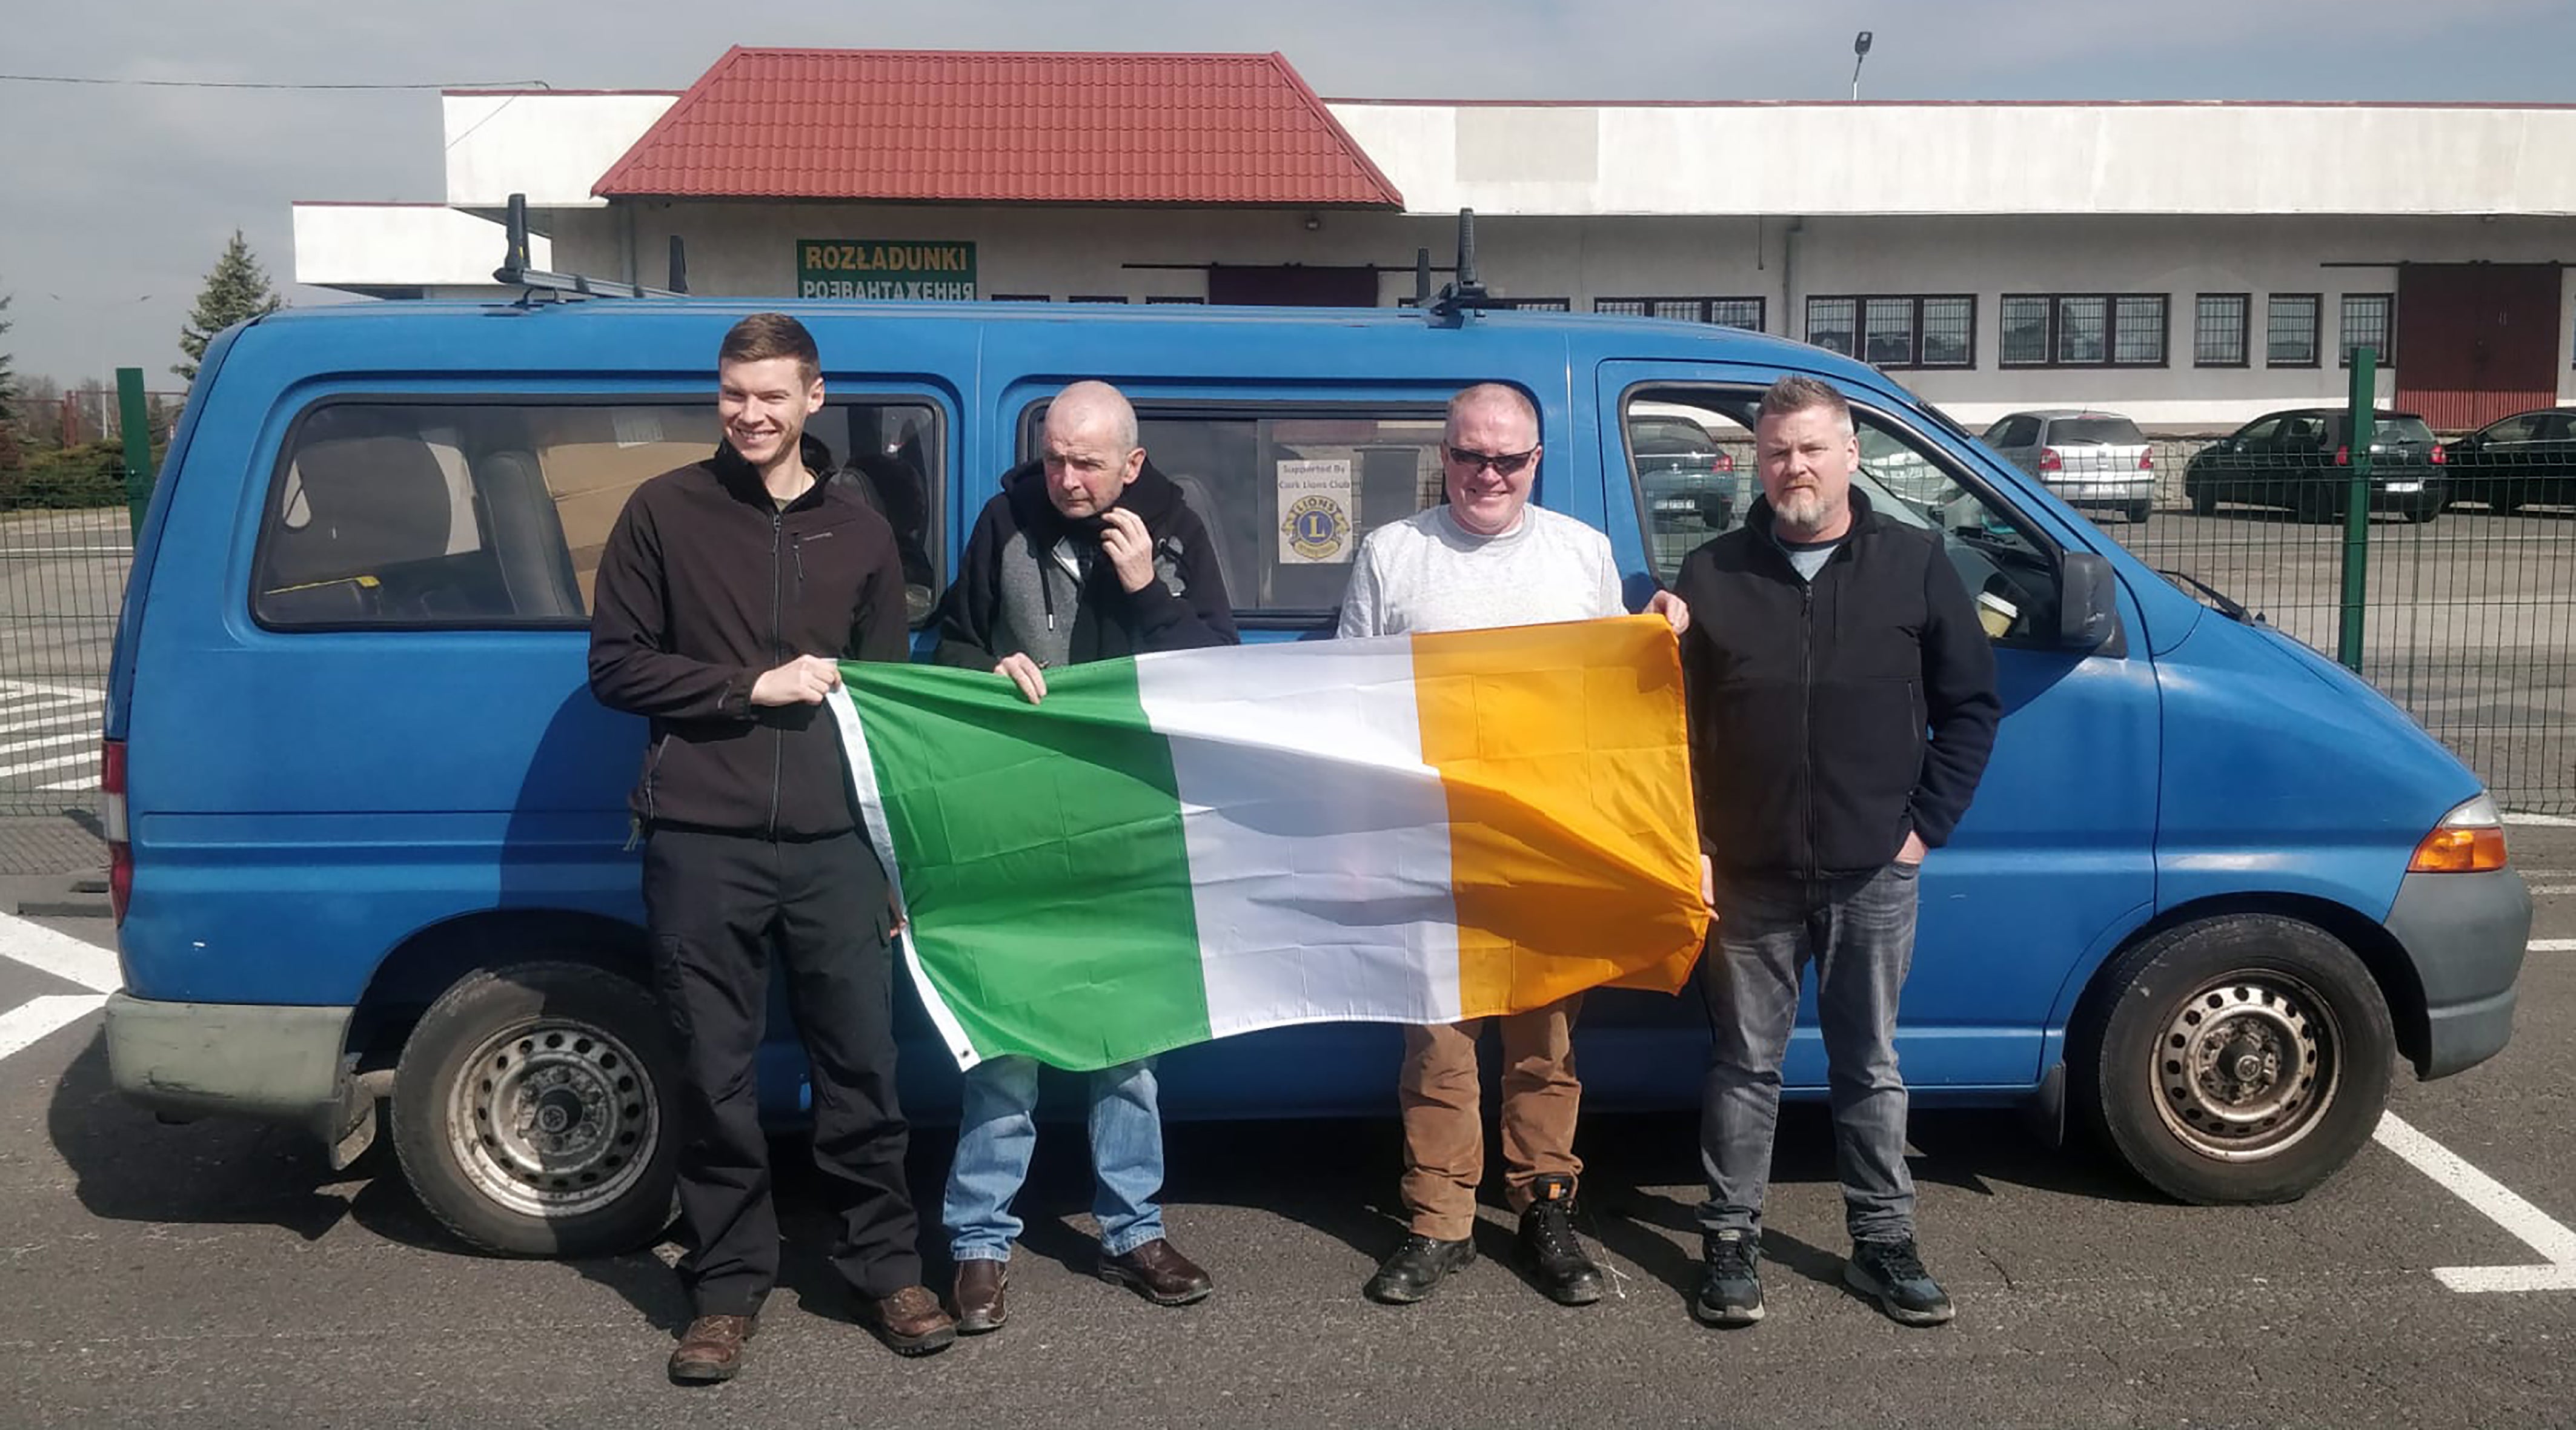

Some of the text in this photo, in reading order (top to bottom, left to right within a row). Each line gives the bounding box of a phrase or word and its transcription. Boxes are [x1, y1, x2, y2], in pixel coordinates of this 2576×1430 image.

[806, 246, 967, 270] ROZŁADUNKI
[1284, 465, 1332, 475] Supported
[1303, 480, 1327, 489] Lions
[1330, 480, 1350, 489] Club
[1296, 498, 1334, 512] LIONS
[1309, 515, 1326, 537] L
